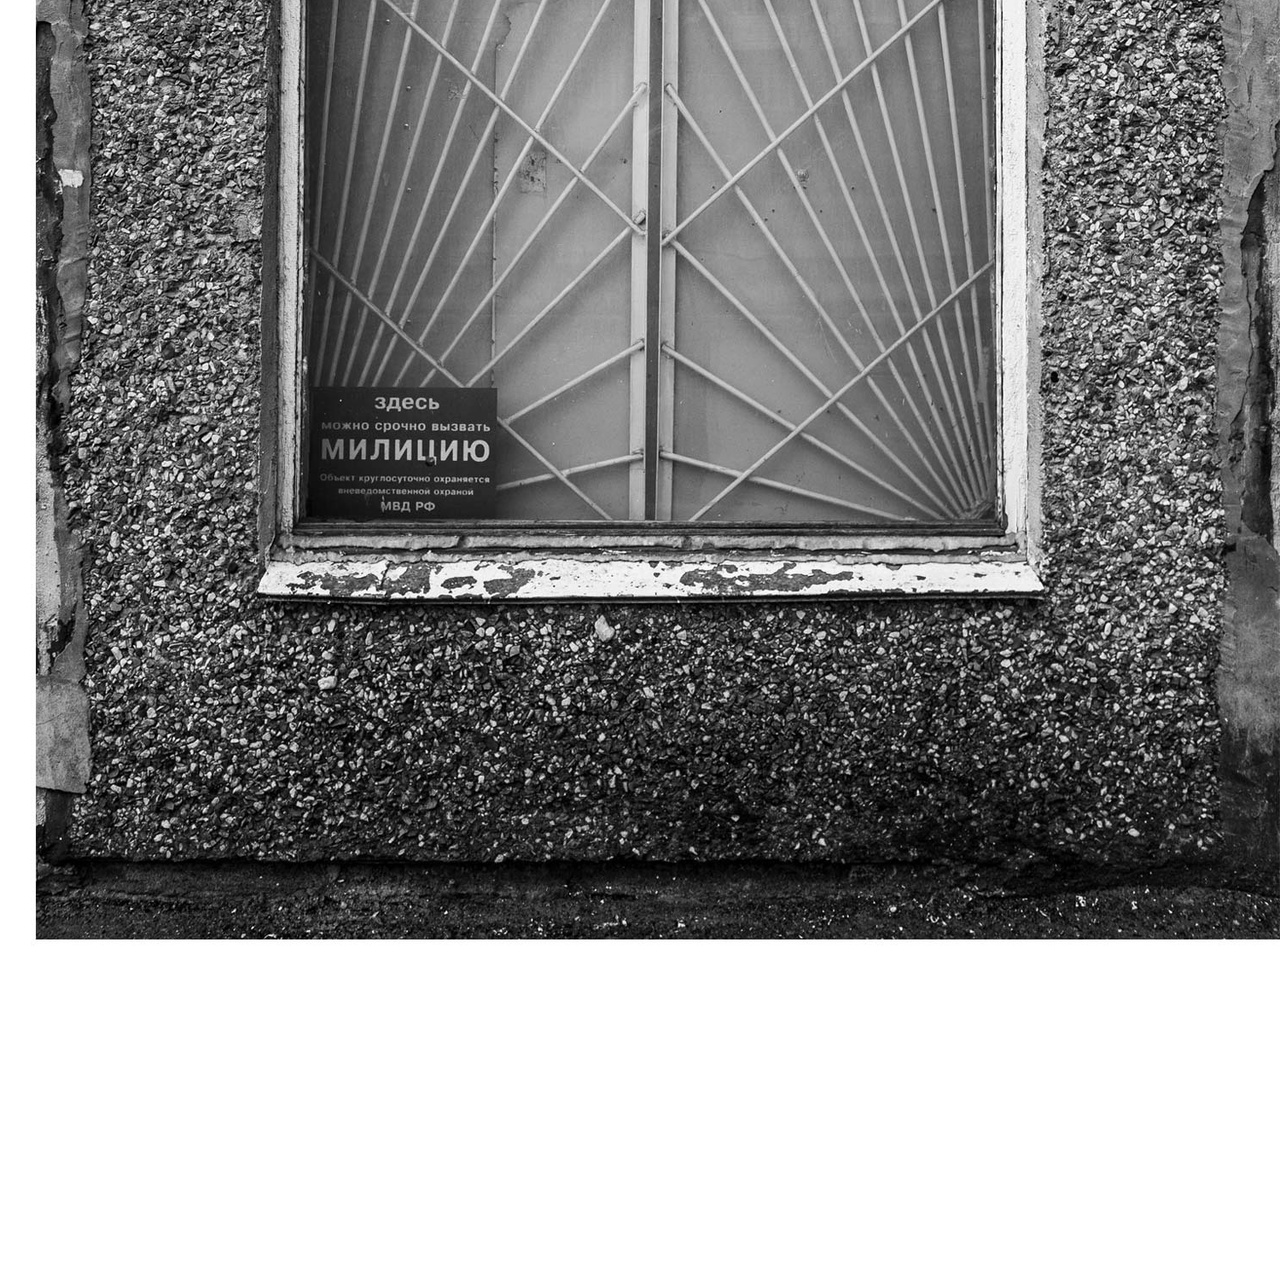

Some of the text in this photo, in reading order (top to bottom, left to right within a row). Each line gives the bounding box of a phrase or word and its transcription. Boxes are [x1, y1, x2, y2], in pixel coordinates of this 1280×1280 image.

[321, 422, 491, 432] можно срочно вызвать
[321, 438, 490, 465] МИЛИЦИЮ
[320, 473, 490, 484] Объект круглосуточно охраняется
[338, 487, 474, 497] вневедомственной охраной
[381, 501, 436, 512] МВД РФ
